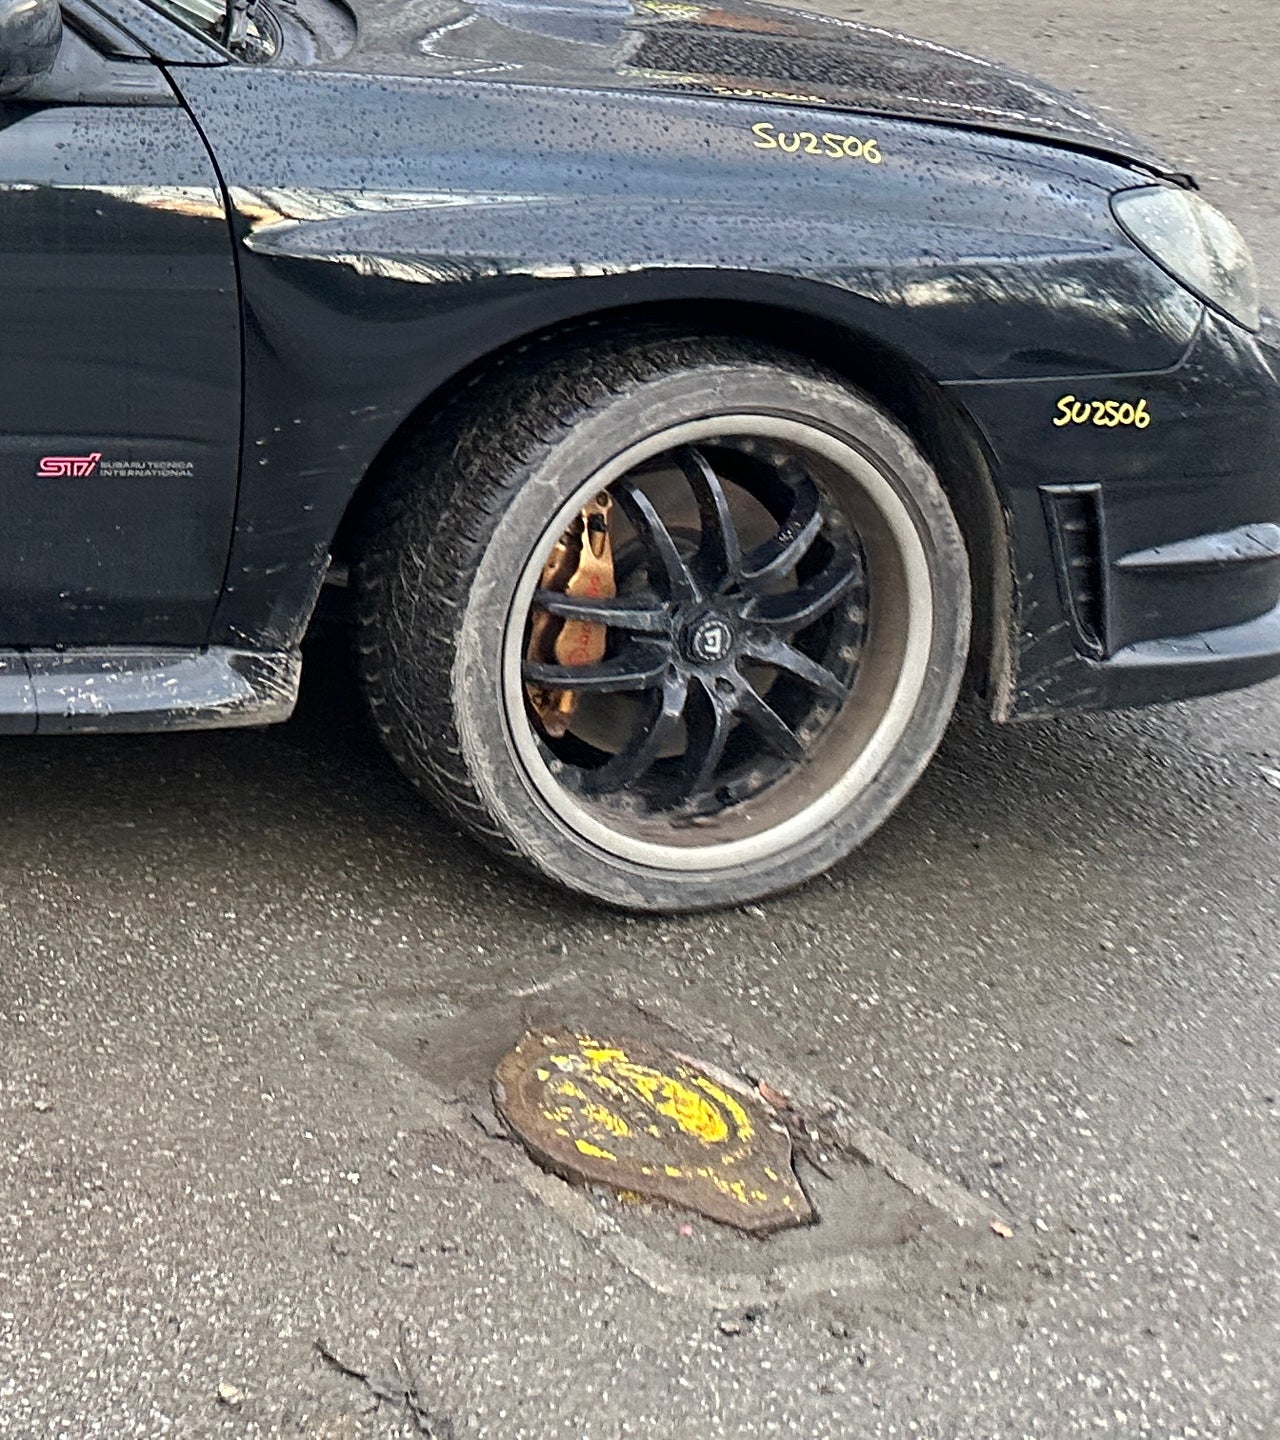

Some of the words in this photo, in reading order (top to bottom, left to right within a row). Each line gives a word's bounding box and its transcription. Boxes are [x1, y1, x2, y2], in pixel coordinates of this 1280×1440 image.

[751, 122, 882, 163] SU2506
[1052, 394, 1152, 429] SU2506
[101, 461, 146, 469] SUBARU
[101, 469, 194, 477] INTERNATIONAL
